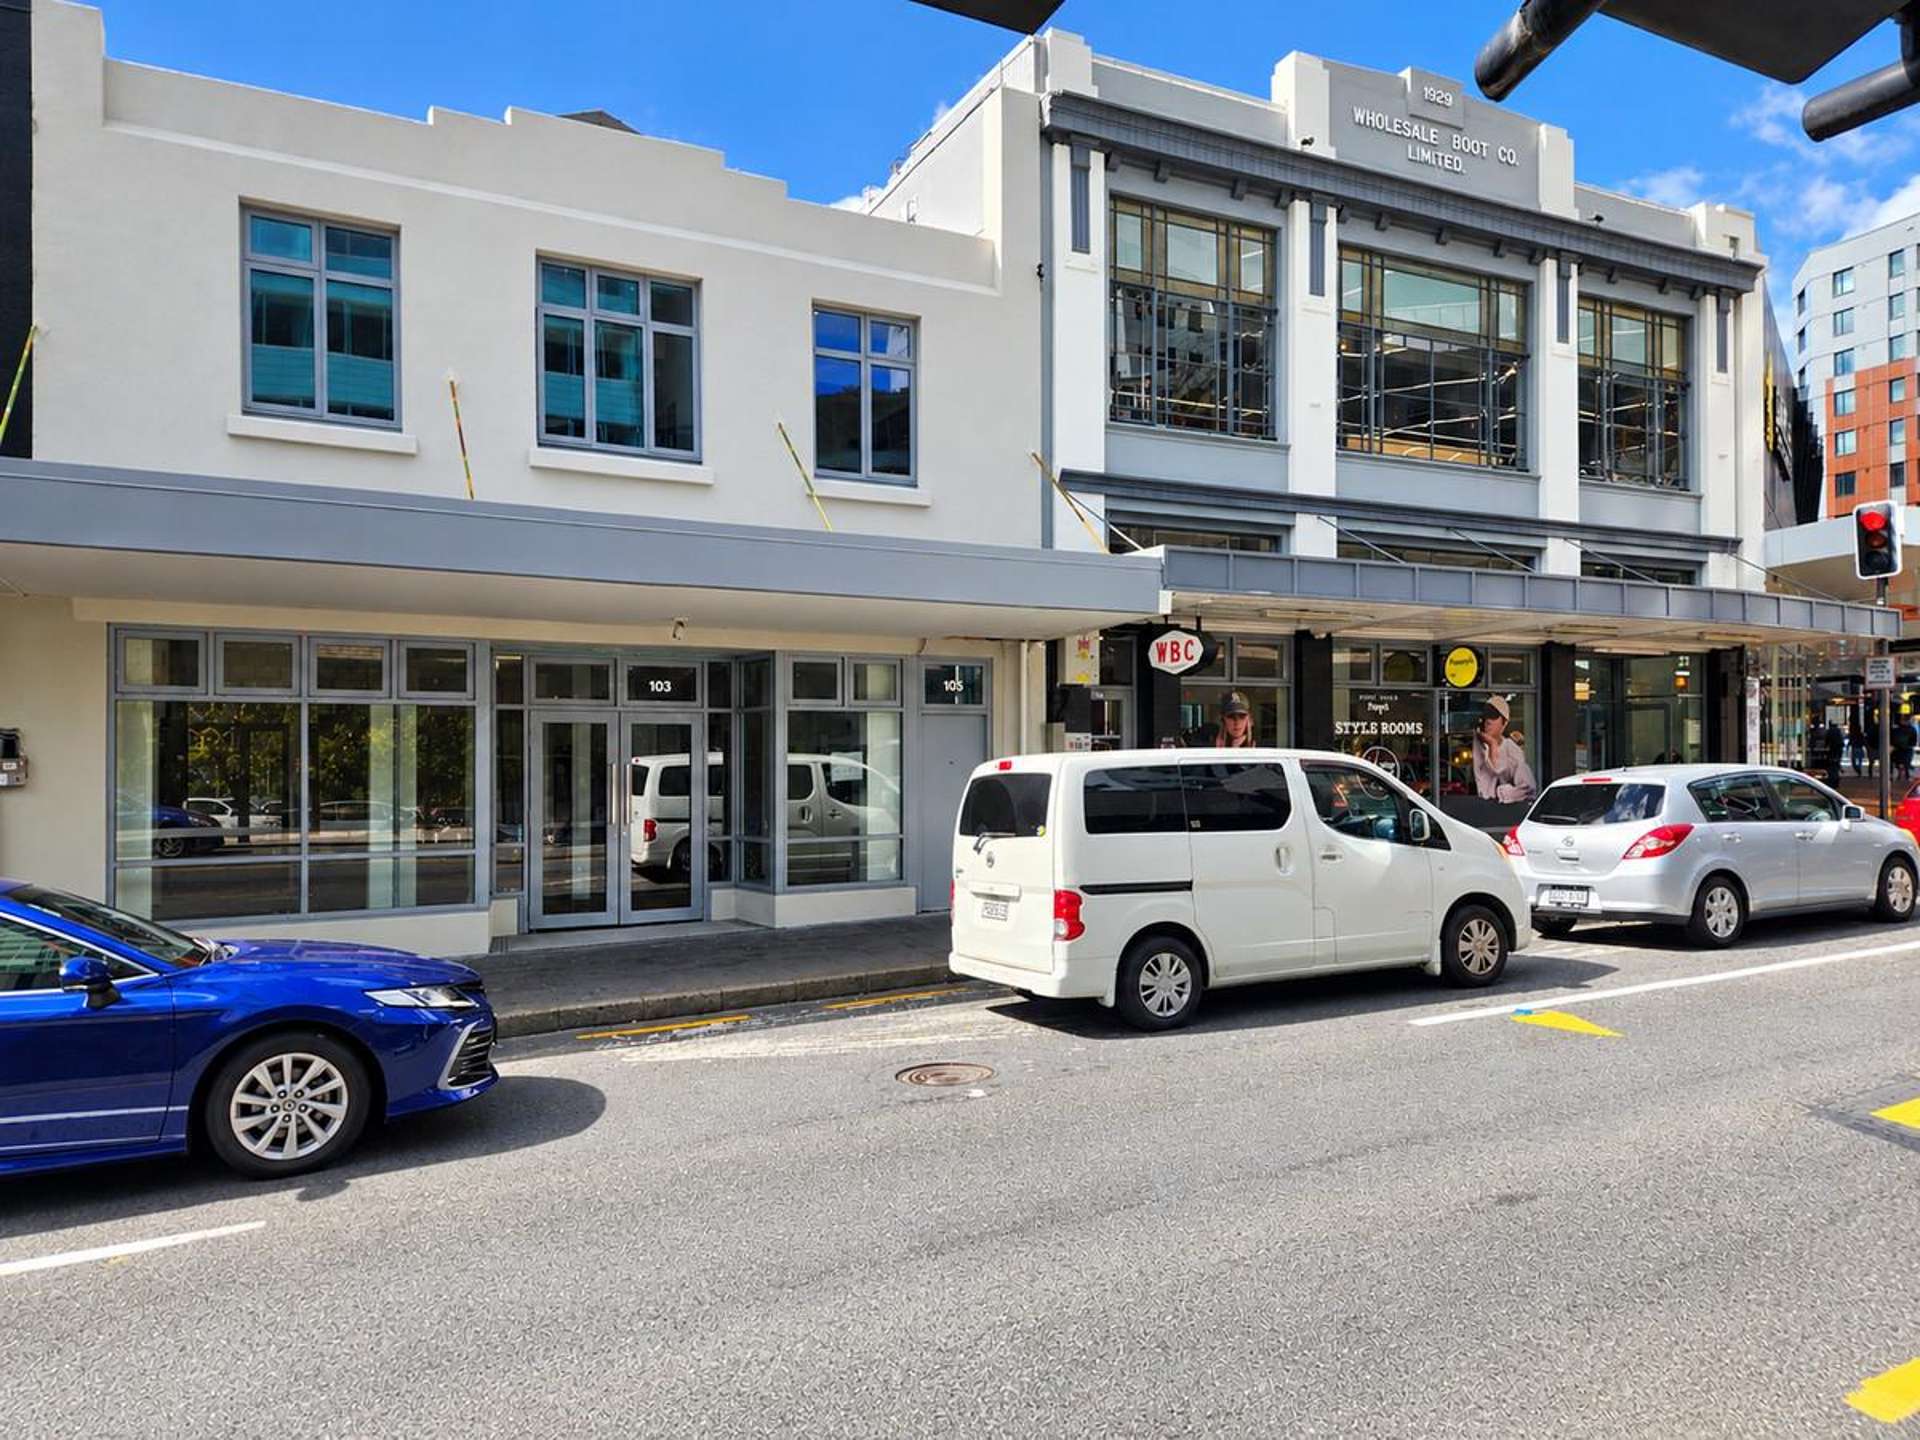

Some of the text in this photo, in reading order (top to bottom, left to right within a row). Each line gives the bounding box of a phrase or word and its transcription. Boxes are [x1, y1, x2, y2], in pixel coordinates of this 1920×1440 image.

[1423, 86, 1453, 107] 1929
[1353, 106, 1519, 165] WHOLESALE BOOT CO.
[1407, 144, 1466, 174] LIMITED.
[1155, 639, 1195, 663] WBC
[649, 680, 672, 692] 103
[943, 680, 964, 691] 105
[1335, 721, 1423, 735] STYLE ROOMS
